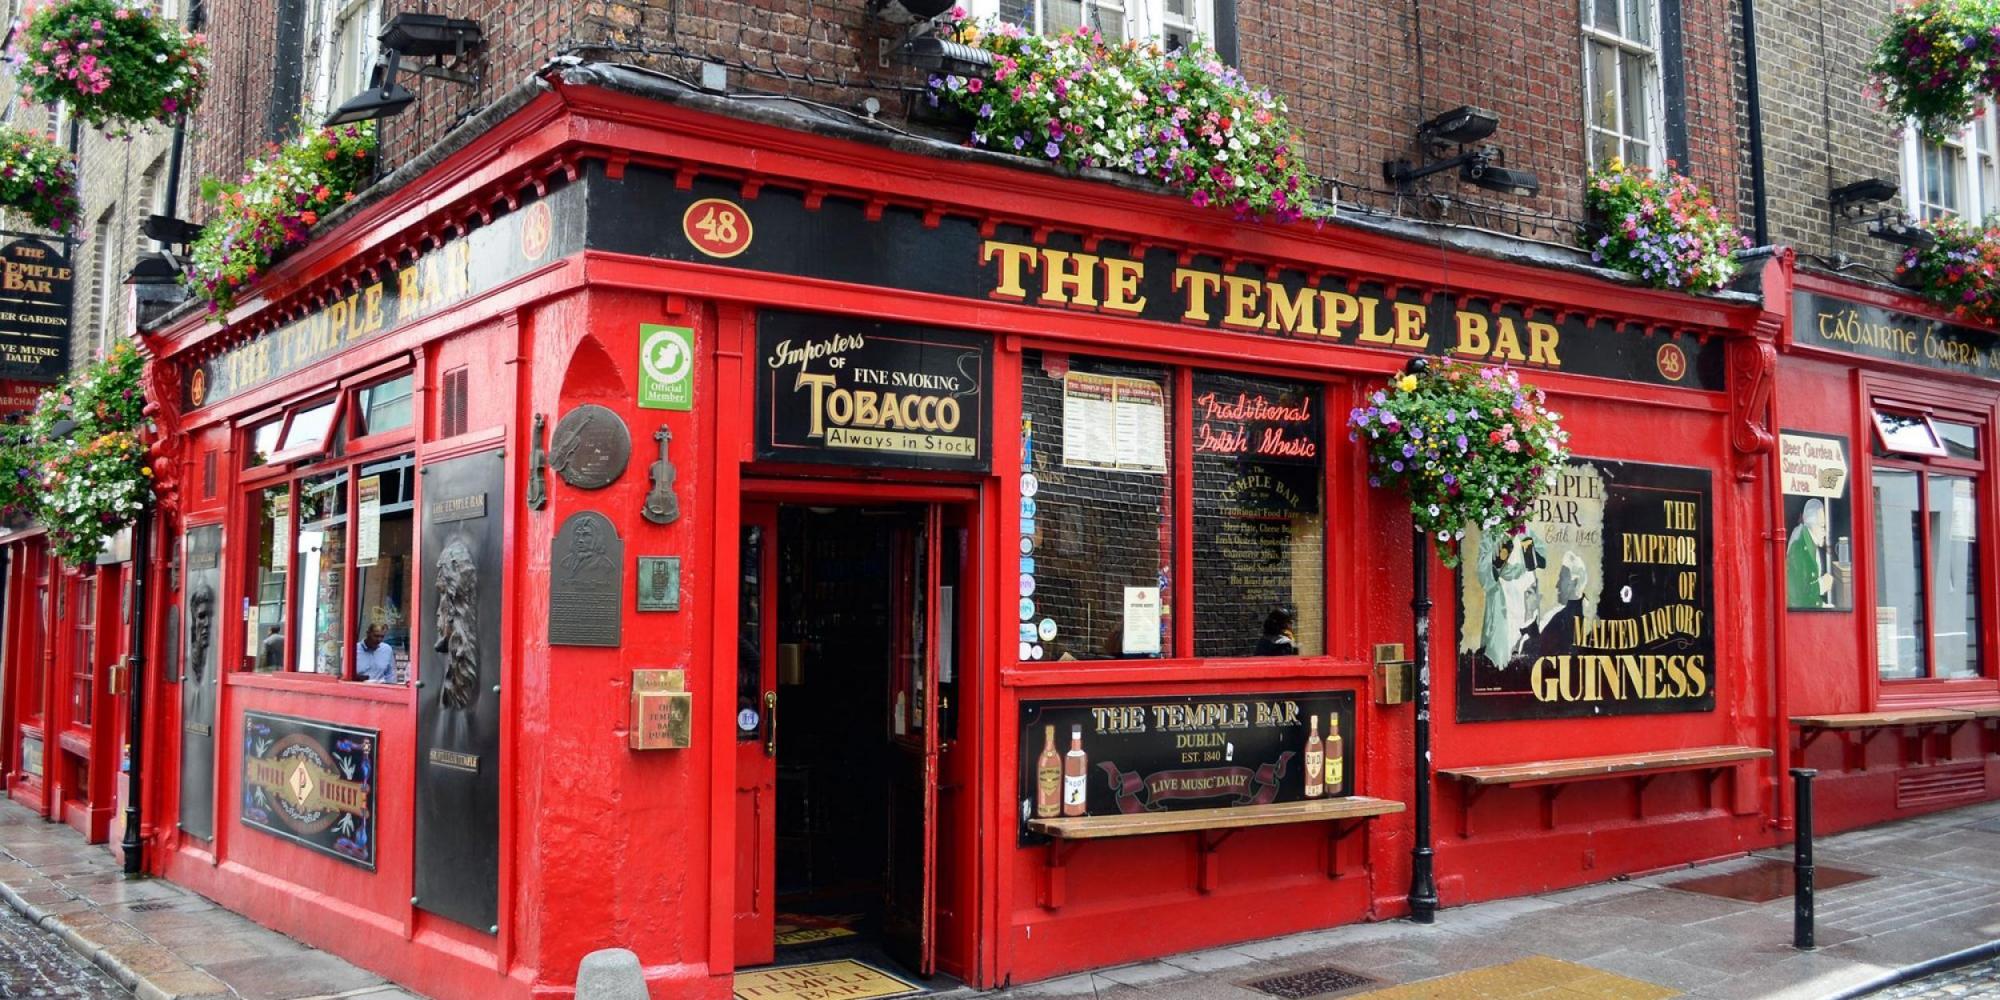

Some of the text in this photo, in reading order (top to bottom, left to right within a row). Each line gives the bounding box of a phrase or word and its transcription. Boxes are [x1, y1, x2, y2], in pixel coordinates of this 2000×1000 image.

[525, 214, 547, 250] 48
[696, 207, 738, 244] 48
[16, 246, 46, 259] THE
[3, 272, 53, 294] BAR
[228, 236, 470, 390] THE TEMPLE BAR
[980, 240, 1562, 368] THE TEMPLE BAR
[19, 314, 68, 326] GARDEN
[6, 353, 43, 364] DAILY
[20, 345, 60, 357] MUSIC
[768, 332, 865, 374] Importers
[829, 356, 847, 369] OF
[1661, 349, 1681, 373] 48
[15, 386, 37, 394] BAR
[651, 383, 682, 393] Official
[854, 368, 960, 391] FINE SMOKING
[0, 396, 35, 406] ERCHA
[648, 391, 686, 402] Member
[794, 371, 961, 438] TOBACCO
[1198, 392, 1311, 421] Traditional
[829, 428, 973, 453] Always in Stock
[1196, 423, 1248, 453] Irish
[1258, 427, 1316, 457] Music
[1783, 439, 1801, 457] Beer
[1804, 442, 1834, 460] Garden
[1783, 456, 1818, 479] Smoking
[1220, 475, 1301, 508] TEMPLE BAR
[1791, 476, 1811, 493] Area
[1538, 499, 1582, 527] BAR
[1664, 499, 1696, 531] THE
[1622, 532, 1696, 566] EMPEROR
[1678, 571, 1696, 600] OF
[1572, 603, 1704, 650] MALTED LIQUORS
[1530, 655, 1706, 701] GUINNESS
[1092, 700, 1302, 733] THE TEMPLE BAR
[1176, 732, 1226, 750] DUBLIN
[1181, 750, 1222, 764] EST. 1840
[320, 778, 358, 807] WHISKEY
[1152, 775, 1248, 794] LIVE MUSIC DAILY
[738, 971, 882, 996] TEMPLE
[755, 968, 831, 982] THE
[796, 985, 872, 1000] BAR
